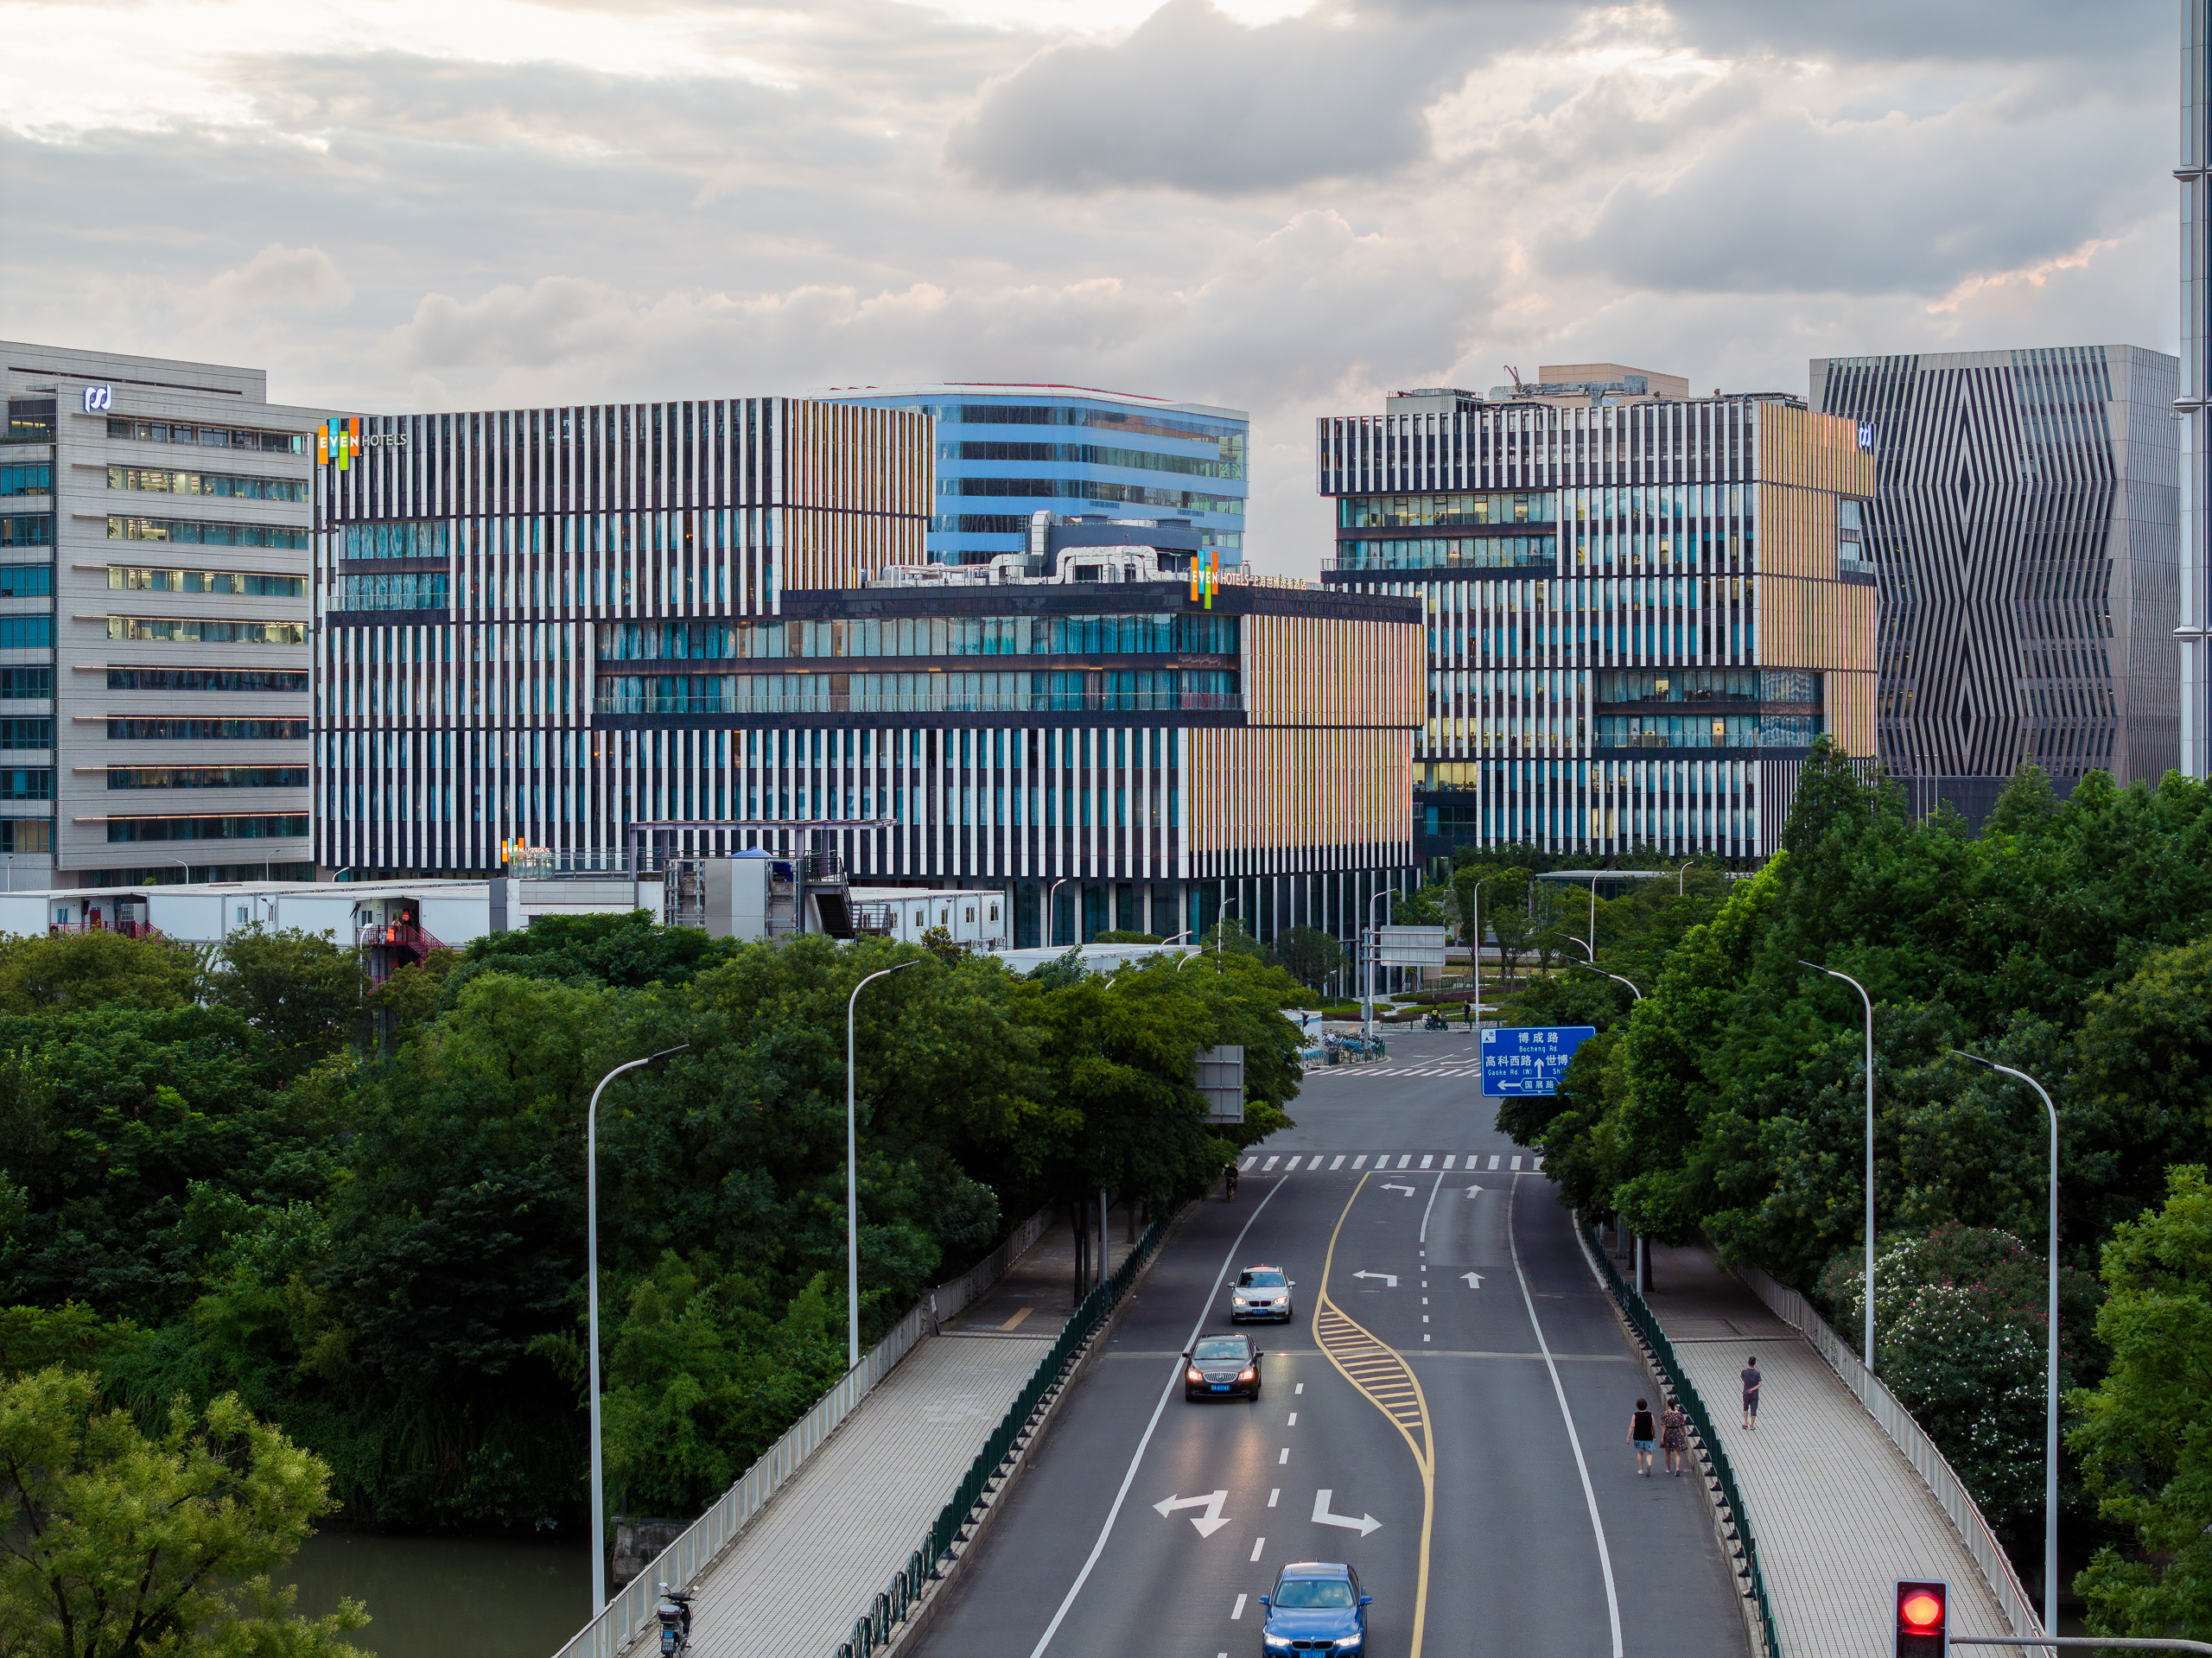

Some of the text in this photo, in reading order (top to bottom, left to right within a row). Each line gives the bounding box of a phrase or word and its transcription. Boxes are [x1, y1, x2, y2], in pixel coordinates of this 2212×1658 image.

[321, 434, 406, 448] EVEN HOTELS
[1192, 569, 1249, 587] EVEN HOTELS
[1518, 1032, 1558, 1044] 博成路
[1485, 1055, 1531, 1067] 高科西路
[1546, 1054, 1570, 1065] 世博
[1525, 1081, 1554, 1089] 国展路
